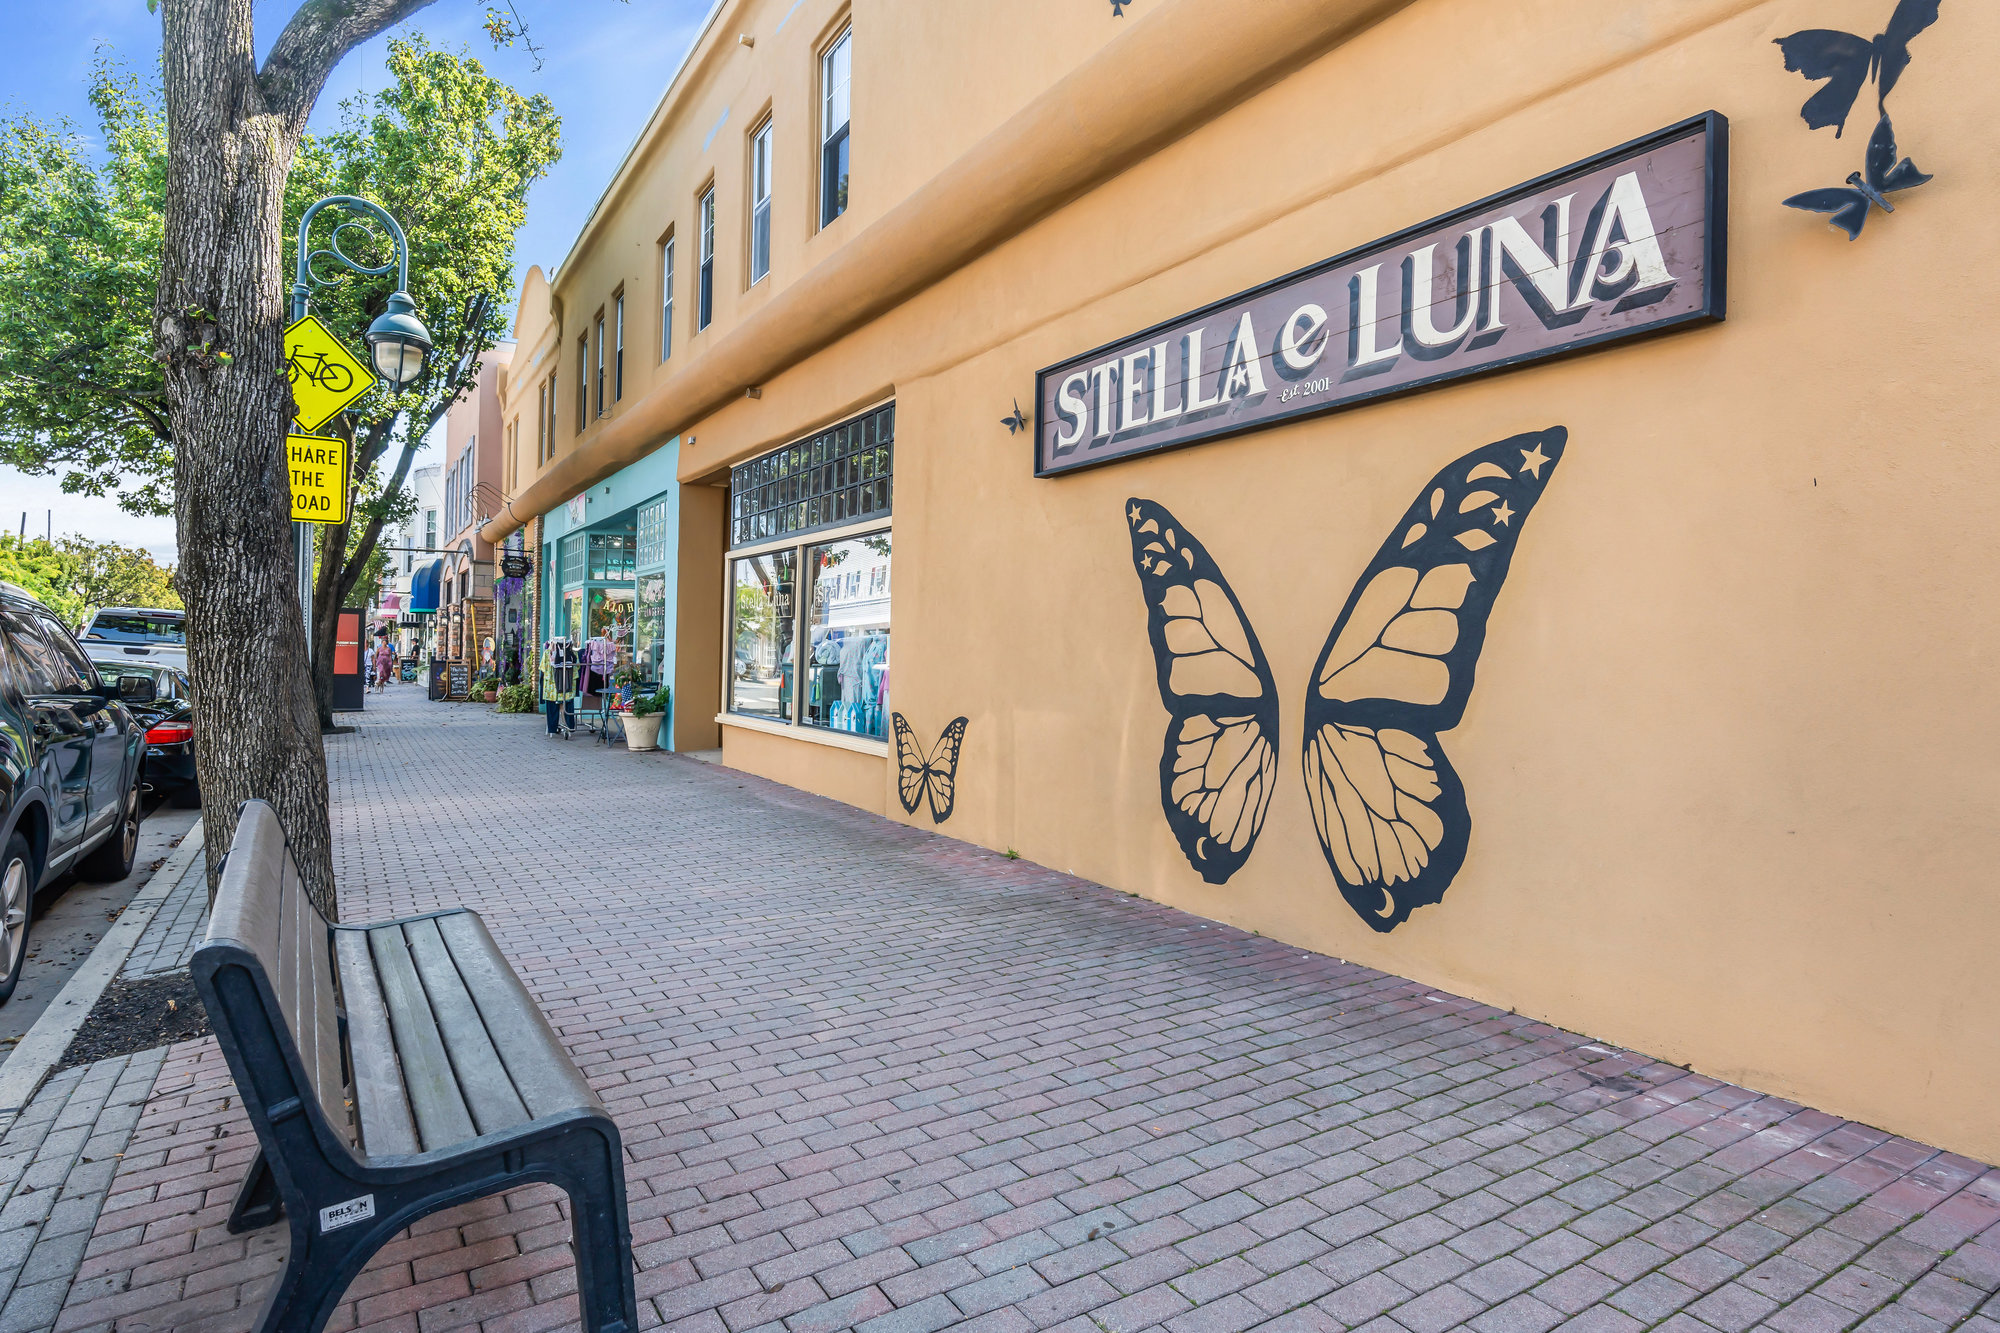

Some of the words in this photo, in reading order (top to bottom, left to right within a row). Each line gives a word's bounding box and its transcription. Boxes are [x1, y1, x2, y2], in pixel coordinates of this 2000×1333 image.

[1055, 311, 1269, 450] STELLA
[1280, 302, 1331, 369] e
[1353, 170, 1680, 370] LUNA
[290, 446, 338, 466] HARE
[291, 470, 325, 488] THE
[328, 1200, 367, 1219] BELSN
